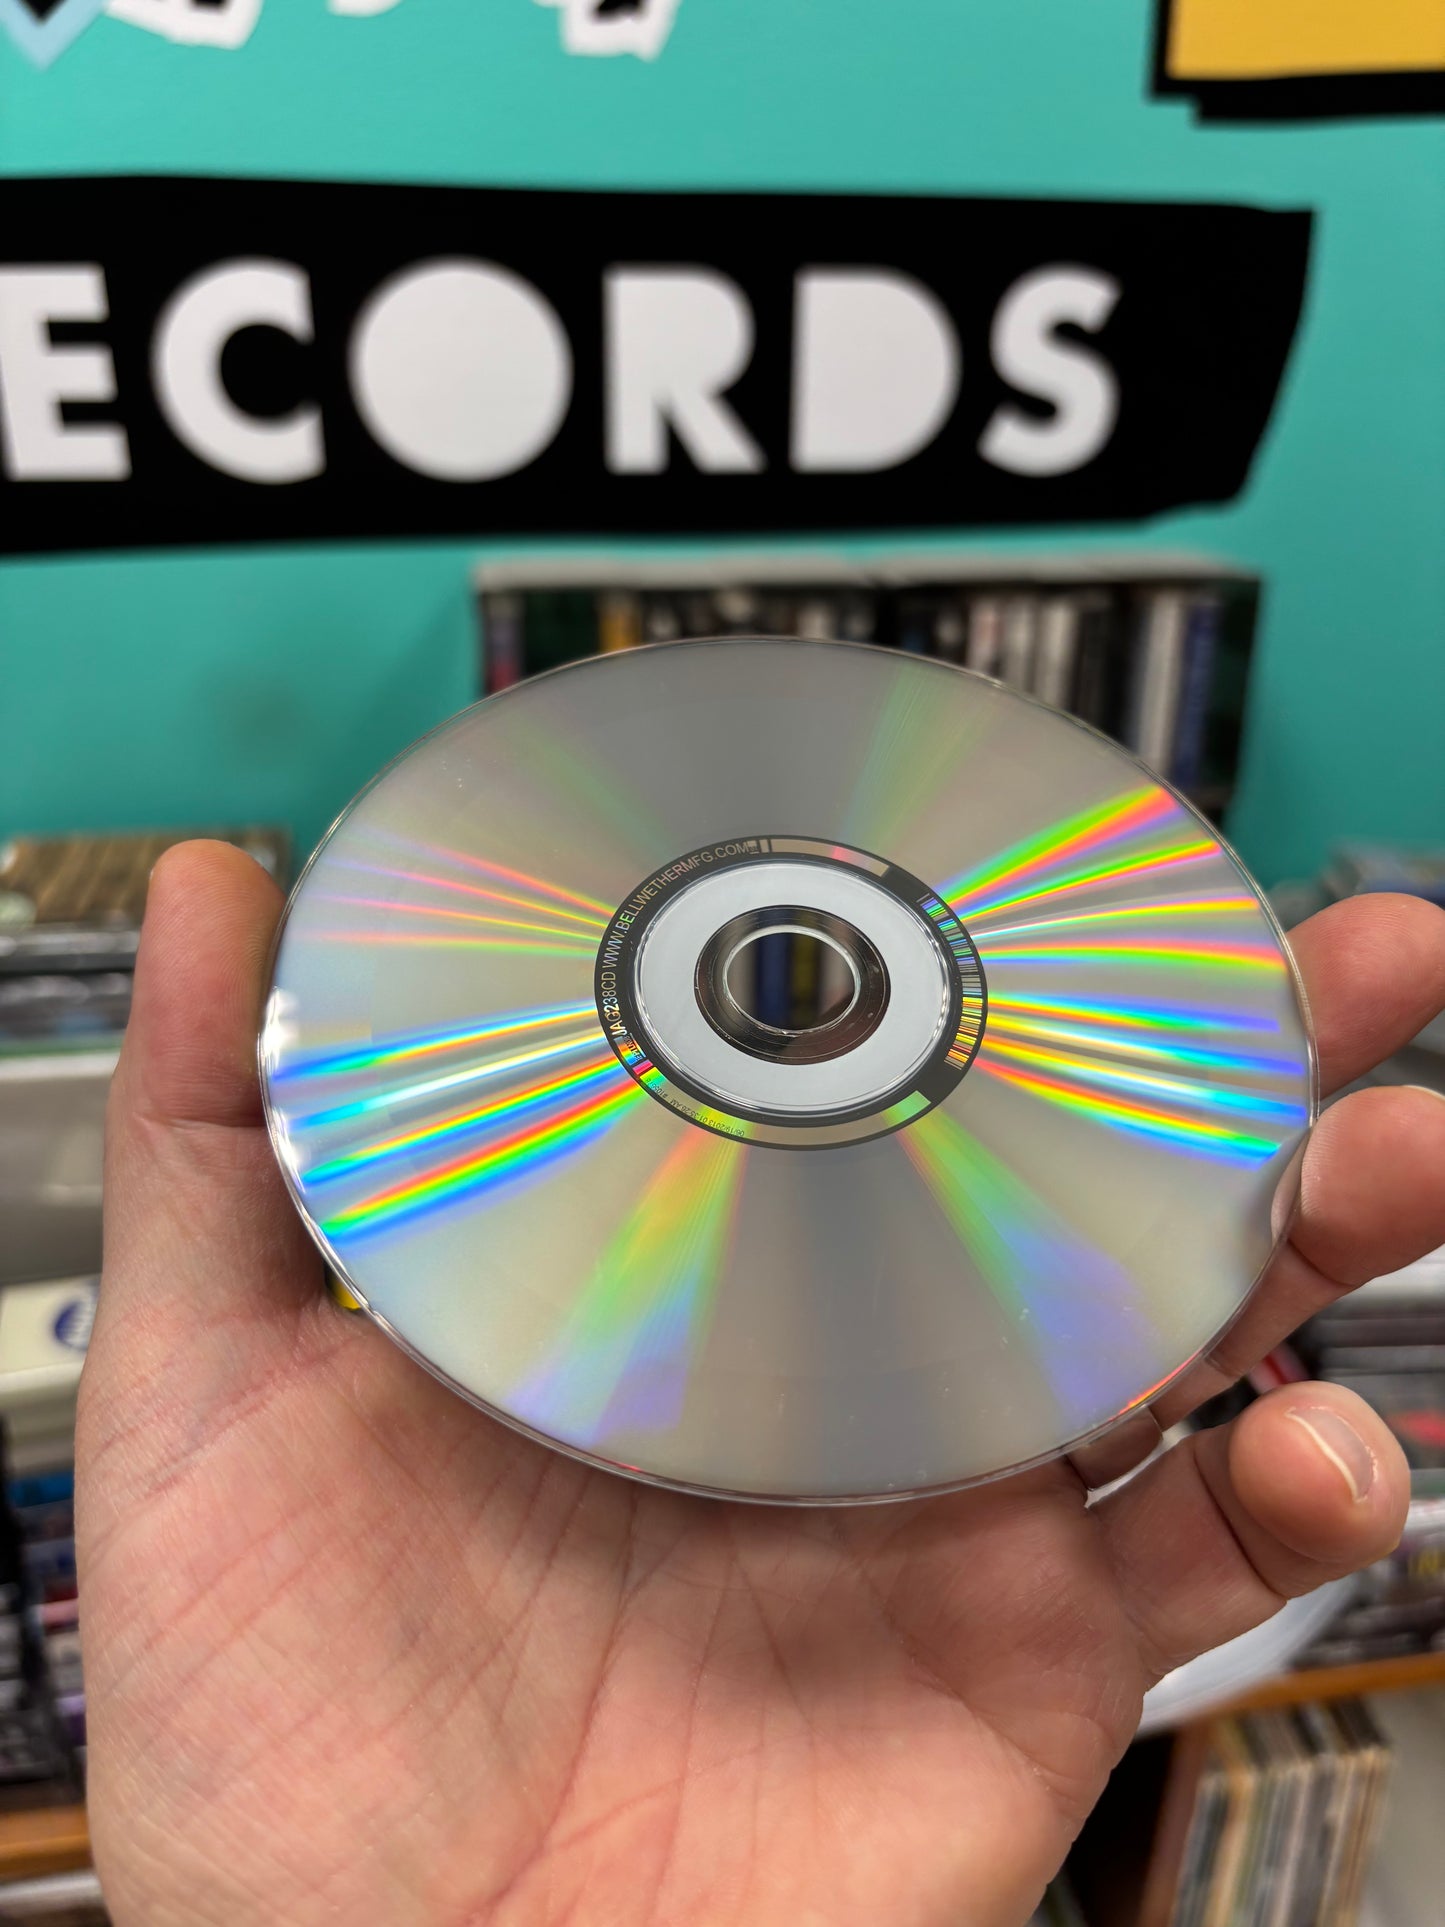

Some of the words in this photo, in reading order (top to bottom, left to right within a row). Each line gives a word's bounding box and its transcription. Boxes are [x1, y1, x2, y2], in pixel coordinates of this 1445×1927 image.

[0, 256, 1122, 484] ECORDS
[602, 840, 750, 969] WWW.BELLWETHERMFG.COM
[601, 972, 627, 1036] JAG238CD
